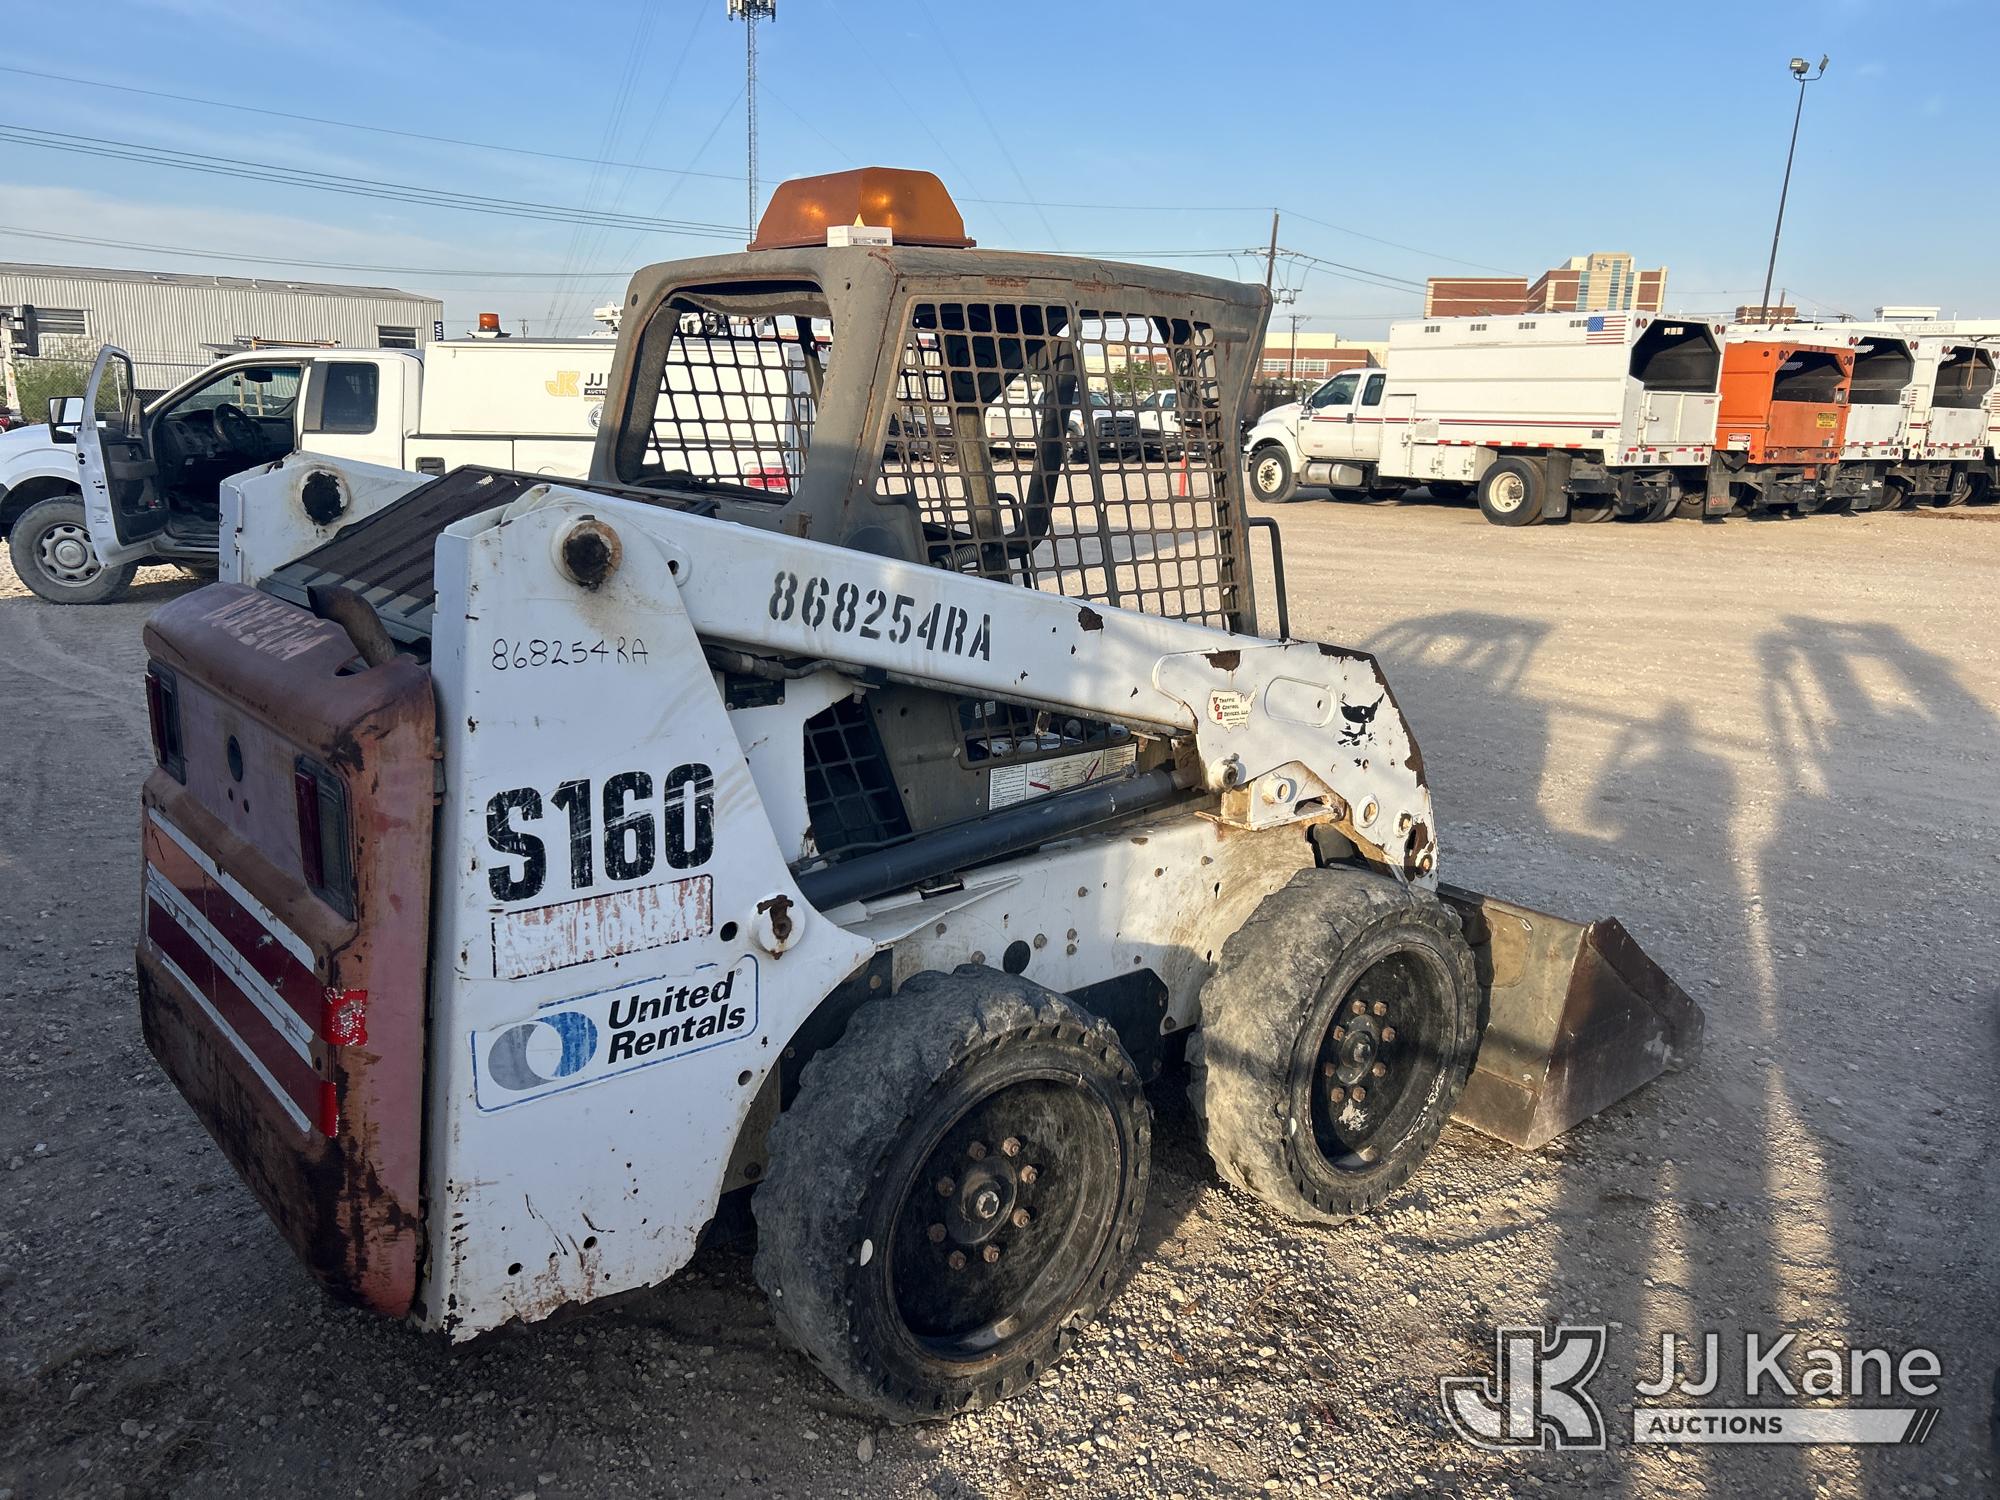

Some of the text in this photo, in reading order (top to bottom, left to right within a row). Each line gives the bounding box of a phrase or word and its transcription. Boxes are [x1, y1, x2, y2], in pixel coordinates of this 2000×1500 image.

[769, 570, 991, 662] 868254RA
[492, 638, 648, 671] 868254RA
[486, 762, 715, 902] S160
[608, 970, 735, 1030] United
[607, 1007, 746, 1064] Rentals
